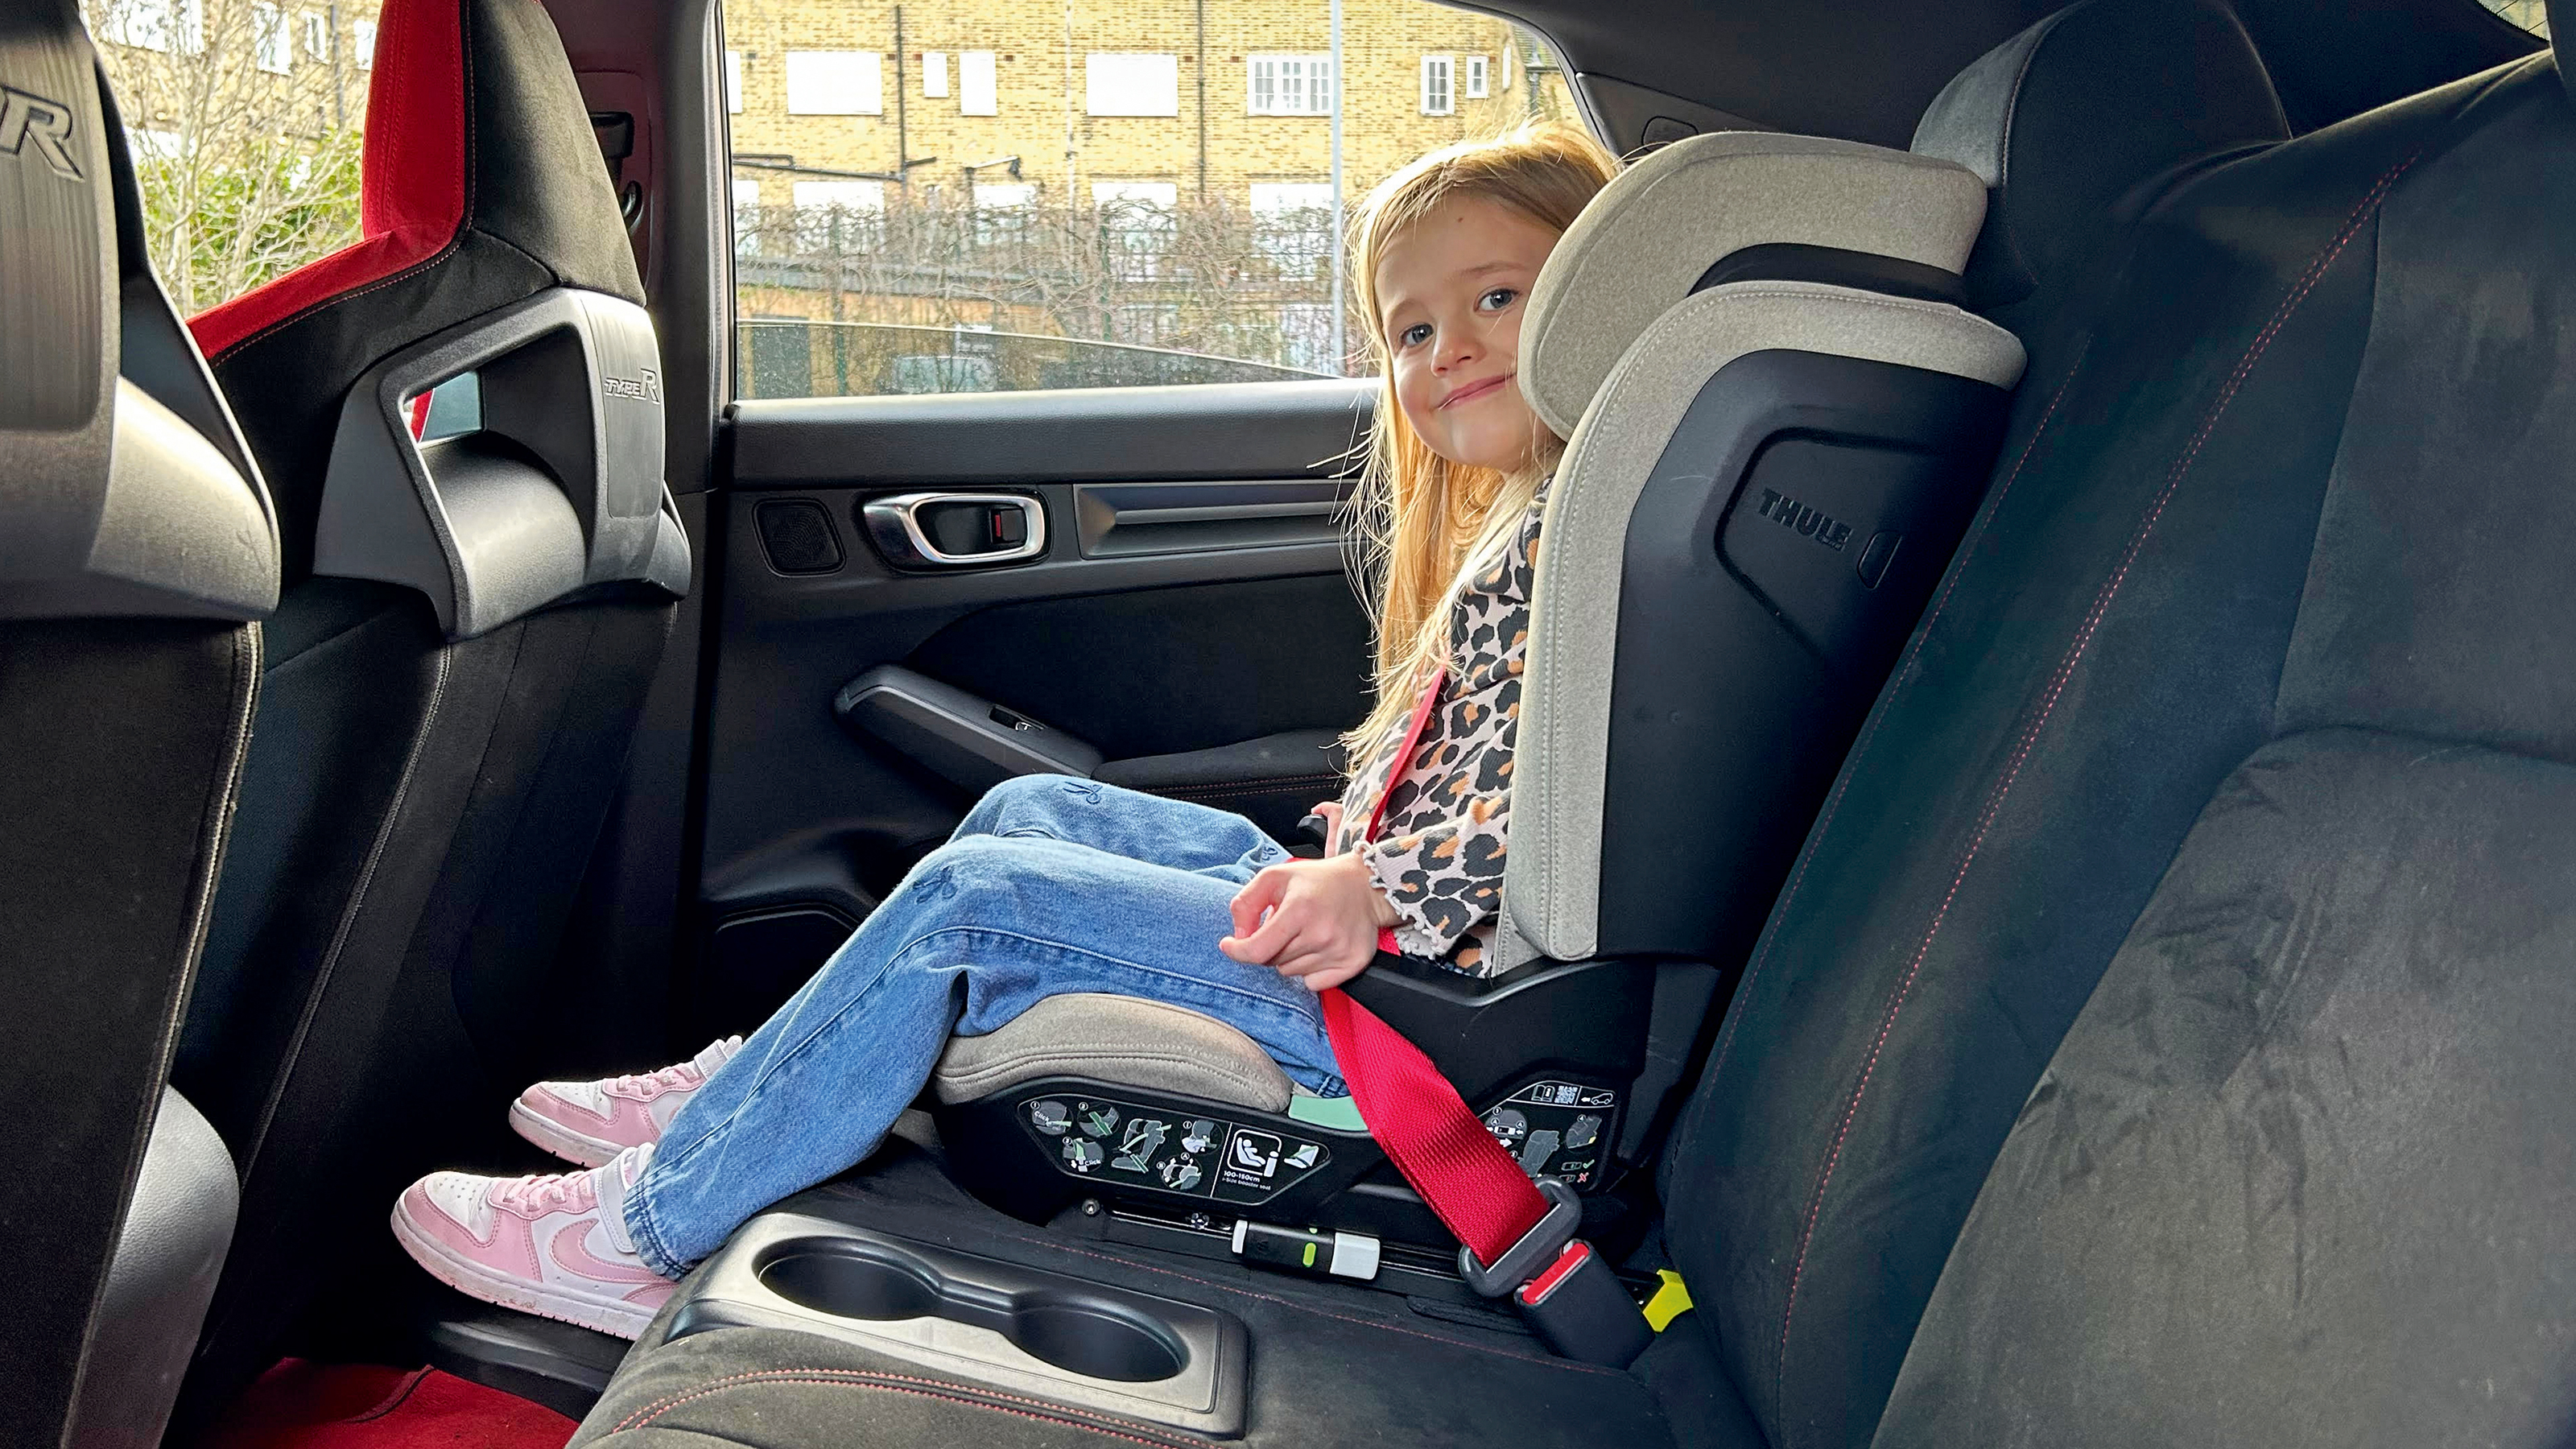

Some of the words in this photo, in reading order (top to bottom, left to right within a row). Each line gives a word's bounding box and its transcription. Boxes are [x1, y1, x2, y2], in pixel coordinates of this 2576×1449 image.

[0, 84, 85, 181] R
[1758, 487, 1853, 551] THULE
[1034, 1111, 1050, 1121] Click
[1224, 1170, 1261, 1183] 100-150cm
